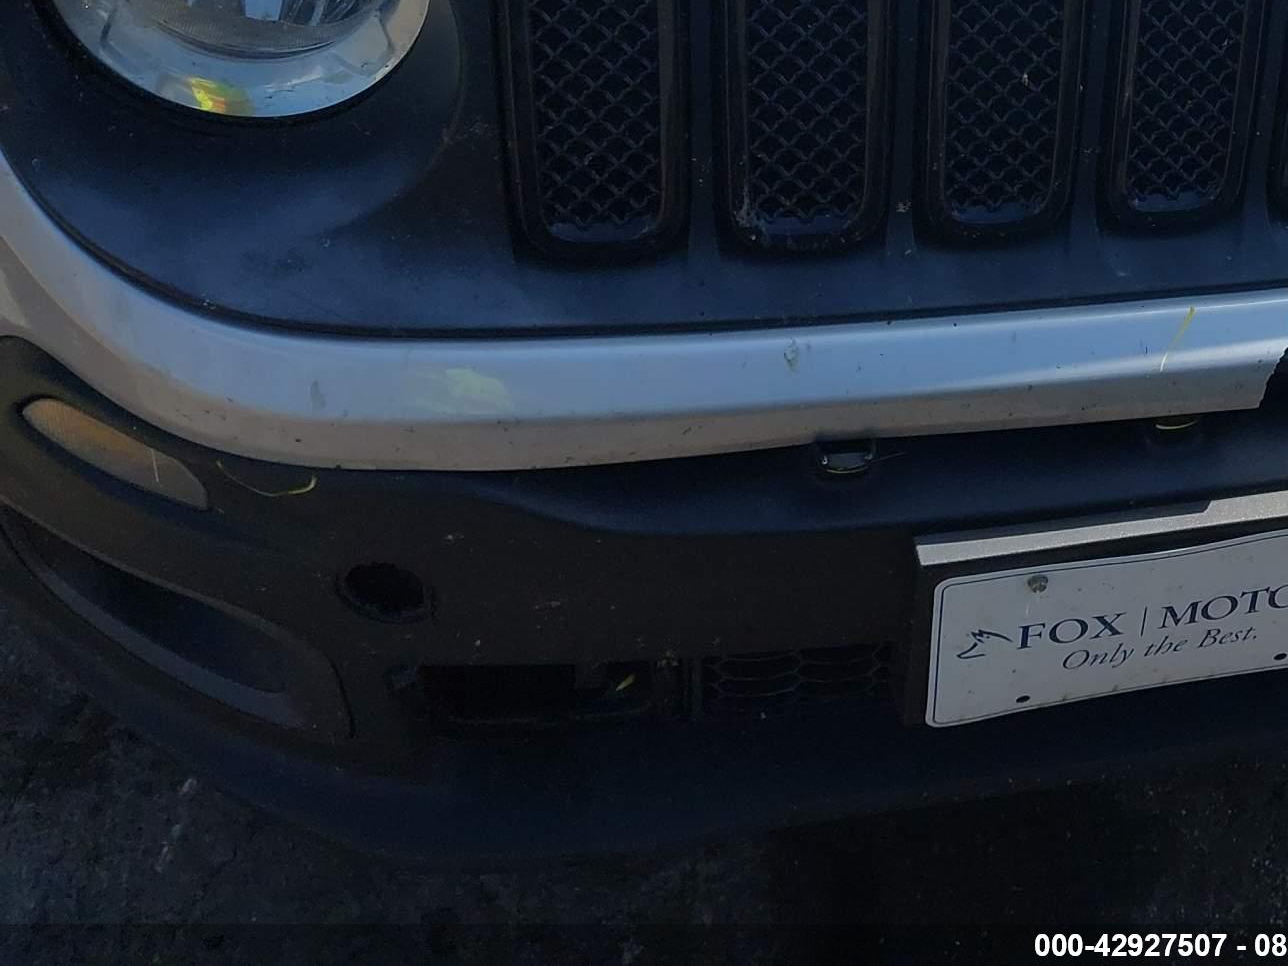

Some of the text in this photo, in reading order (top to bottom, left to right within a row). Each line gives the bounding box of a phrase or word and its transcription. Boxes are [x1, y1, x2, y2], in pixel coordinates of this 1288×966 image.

[1016, 611, 1127, 650] FOX
[1062, 626, 1257, 670] Only the Best.
